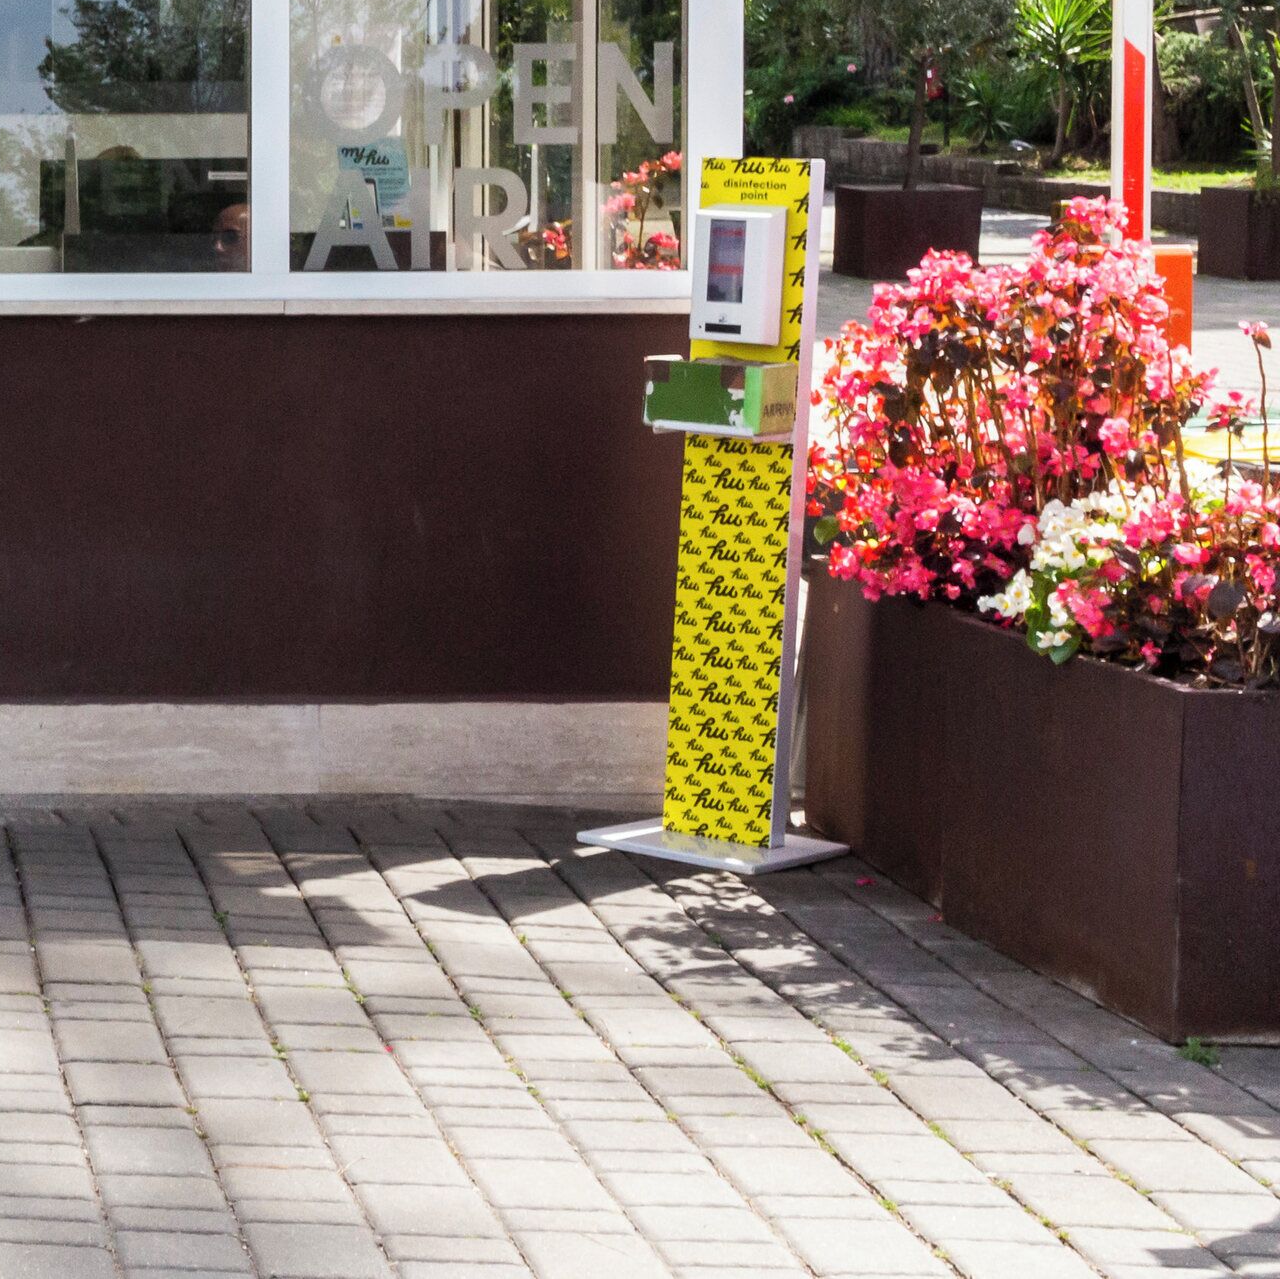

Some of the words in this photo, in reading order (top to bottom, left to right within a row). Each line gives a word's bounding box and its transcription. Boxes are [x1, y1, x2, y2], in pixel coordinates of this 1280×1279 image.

[304, 43, 674, 145] OPEN
[704, 157, 726, 171] hu
[731, 157, 765, 175] hu
[768, 157, 790, 174] hu
[723, 179, 787, 191] disinfection
[740, 190, 768, 201] point
[303, 167, 528, 271] AIR
[686, 469, 706, 484] hu
[712, 468, 744, 491] hu
[749, 476, 770, 491] hu
[681, 540, 701, 555] hu
[707, 540, 740, 563] hu
[744, 548, 765, 563] hu
[677, 611, 697, 626] hu
[703, 611, 735, 634] hu
[739, 619, 760, 635] hu
[672, 682, 692, 697] hu
[698, 682, 731, 705] hu
[735, 691, 756, 707] hu
[668, 752, 688, 766] hu
[694, 753, 726, 776] hu
[730, 762, 751, 778] hu
